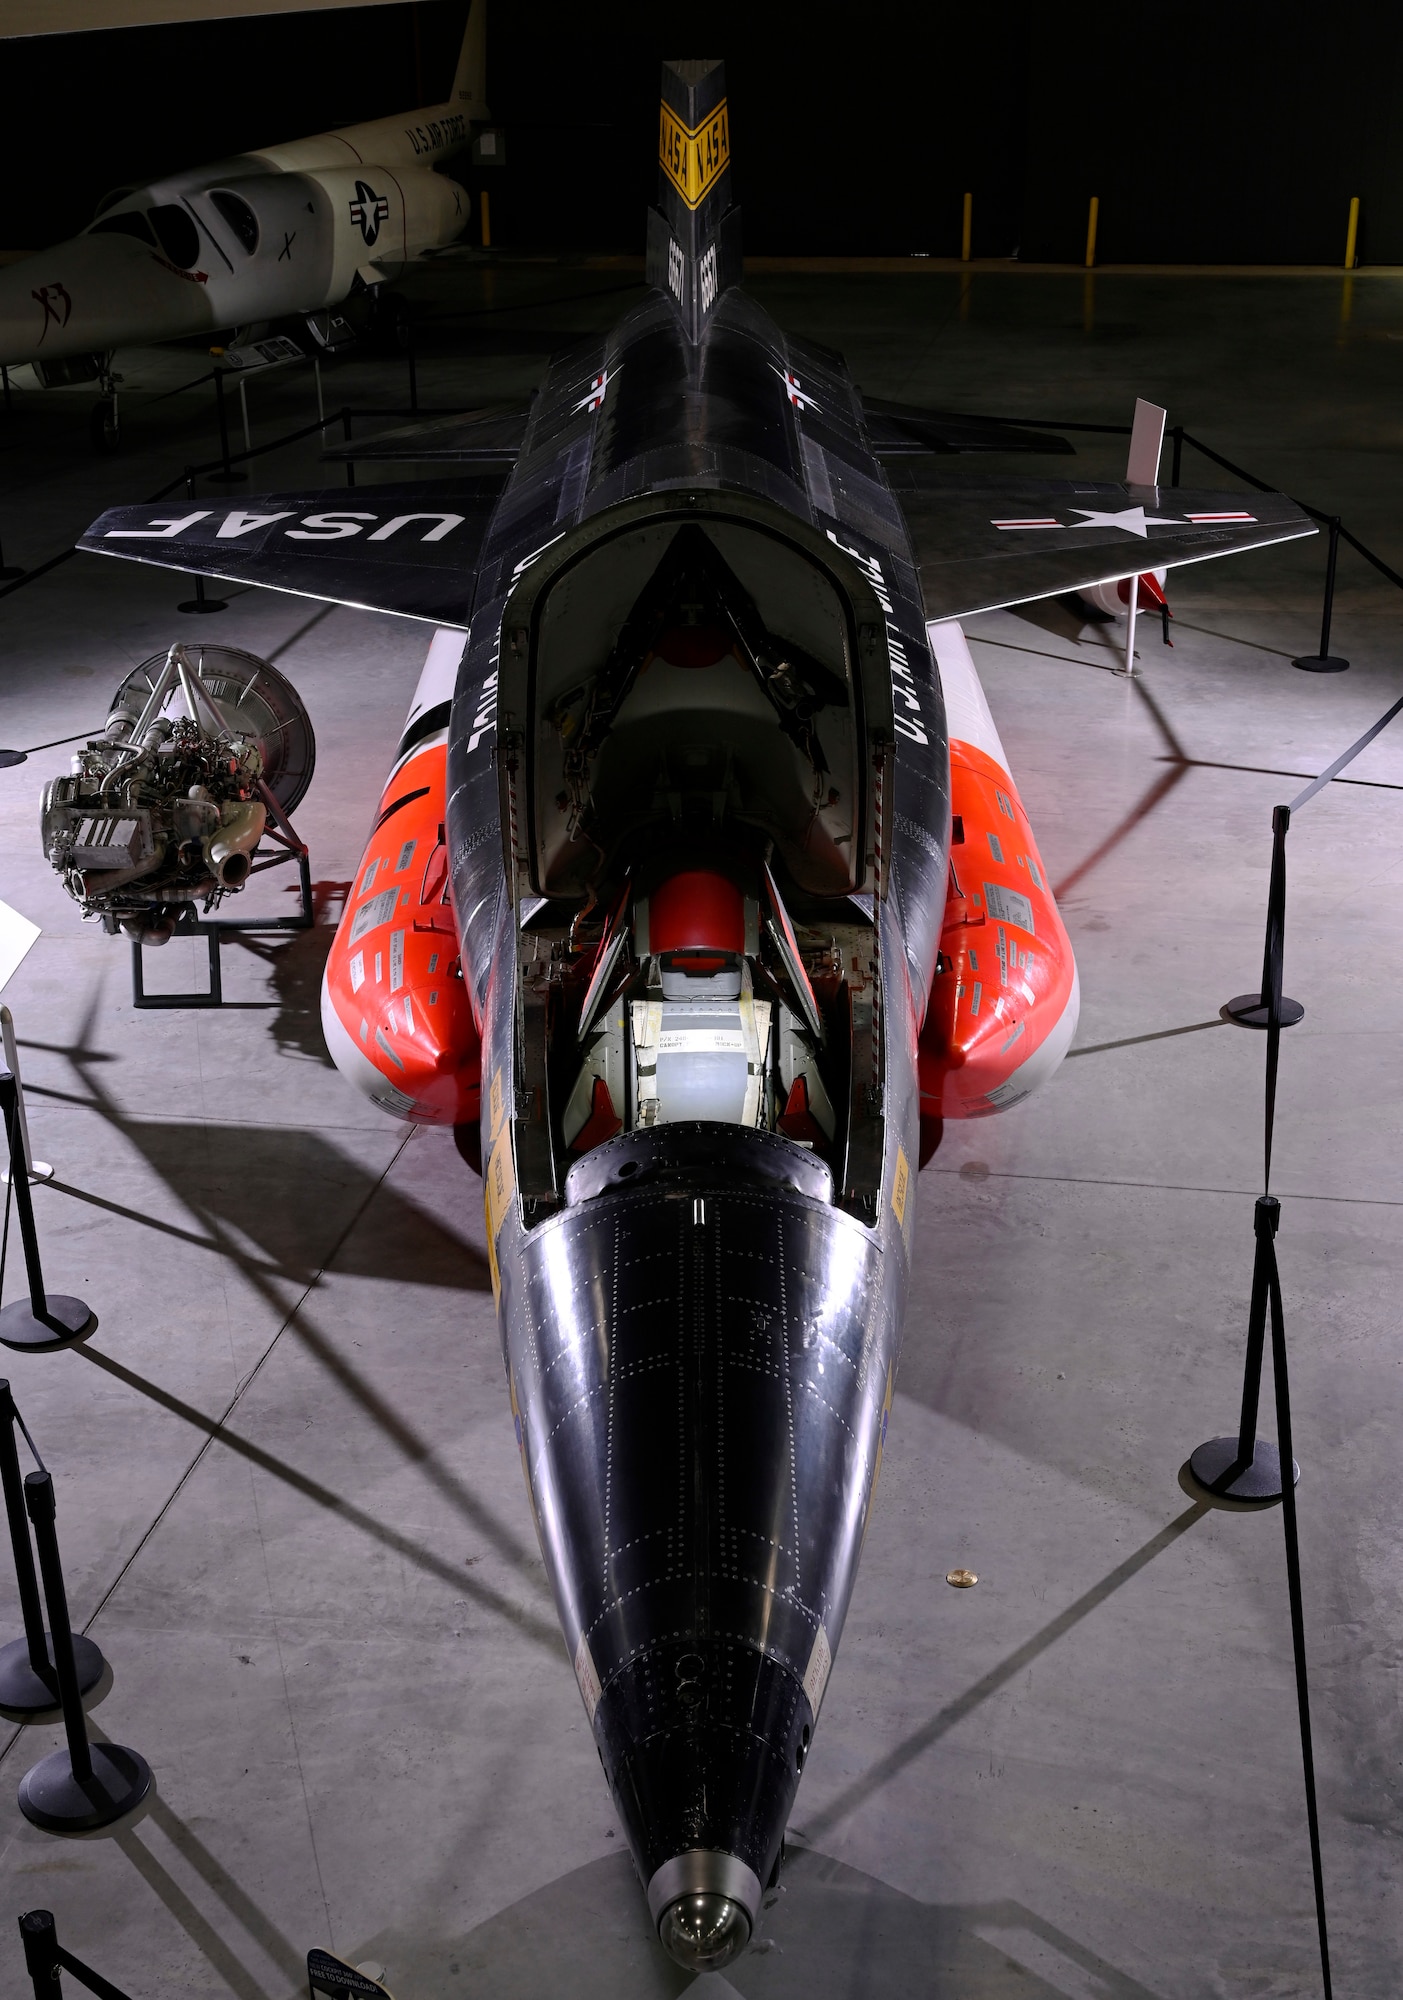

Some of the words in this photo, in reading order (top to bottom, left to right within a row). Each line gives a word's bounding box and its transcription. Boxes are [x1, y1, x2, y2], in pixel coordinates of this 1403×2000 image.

[425, 121, 444, 150] AIR
[440, 114, 466, 146] FORCE
[660, 114, 687, 188] NASA
[696, 113, 728, 188] NASA
[103, 510, 466, 543] USAF
[309, 1967, 327, 1980] FREE
[336, 1975, 379, 1994] DOWNLOAD!
[320, 1964, 342, 1976] COCKPIT
